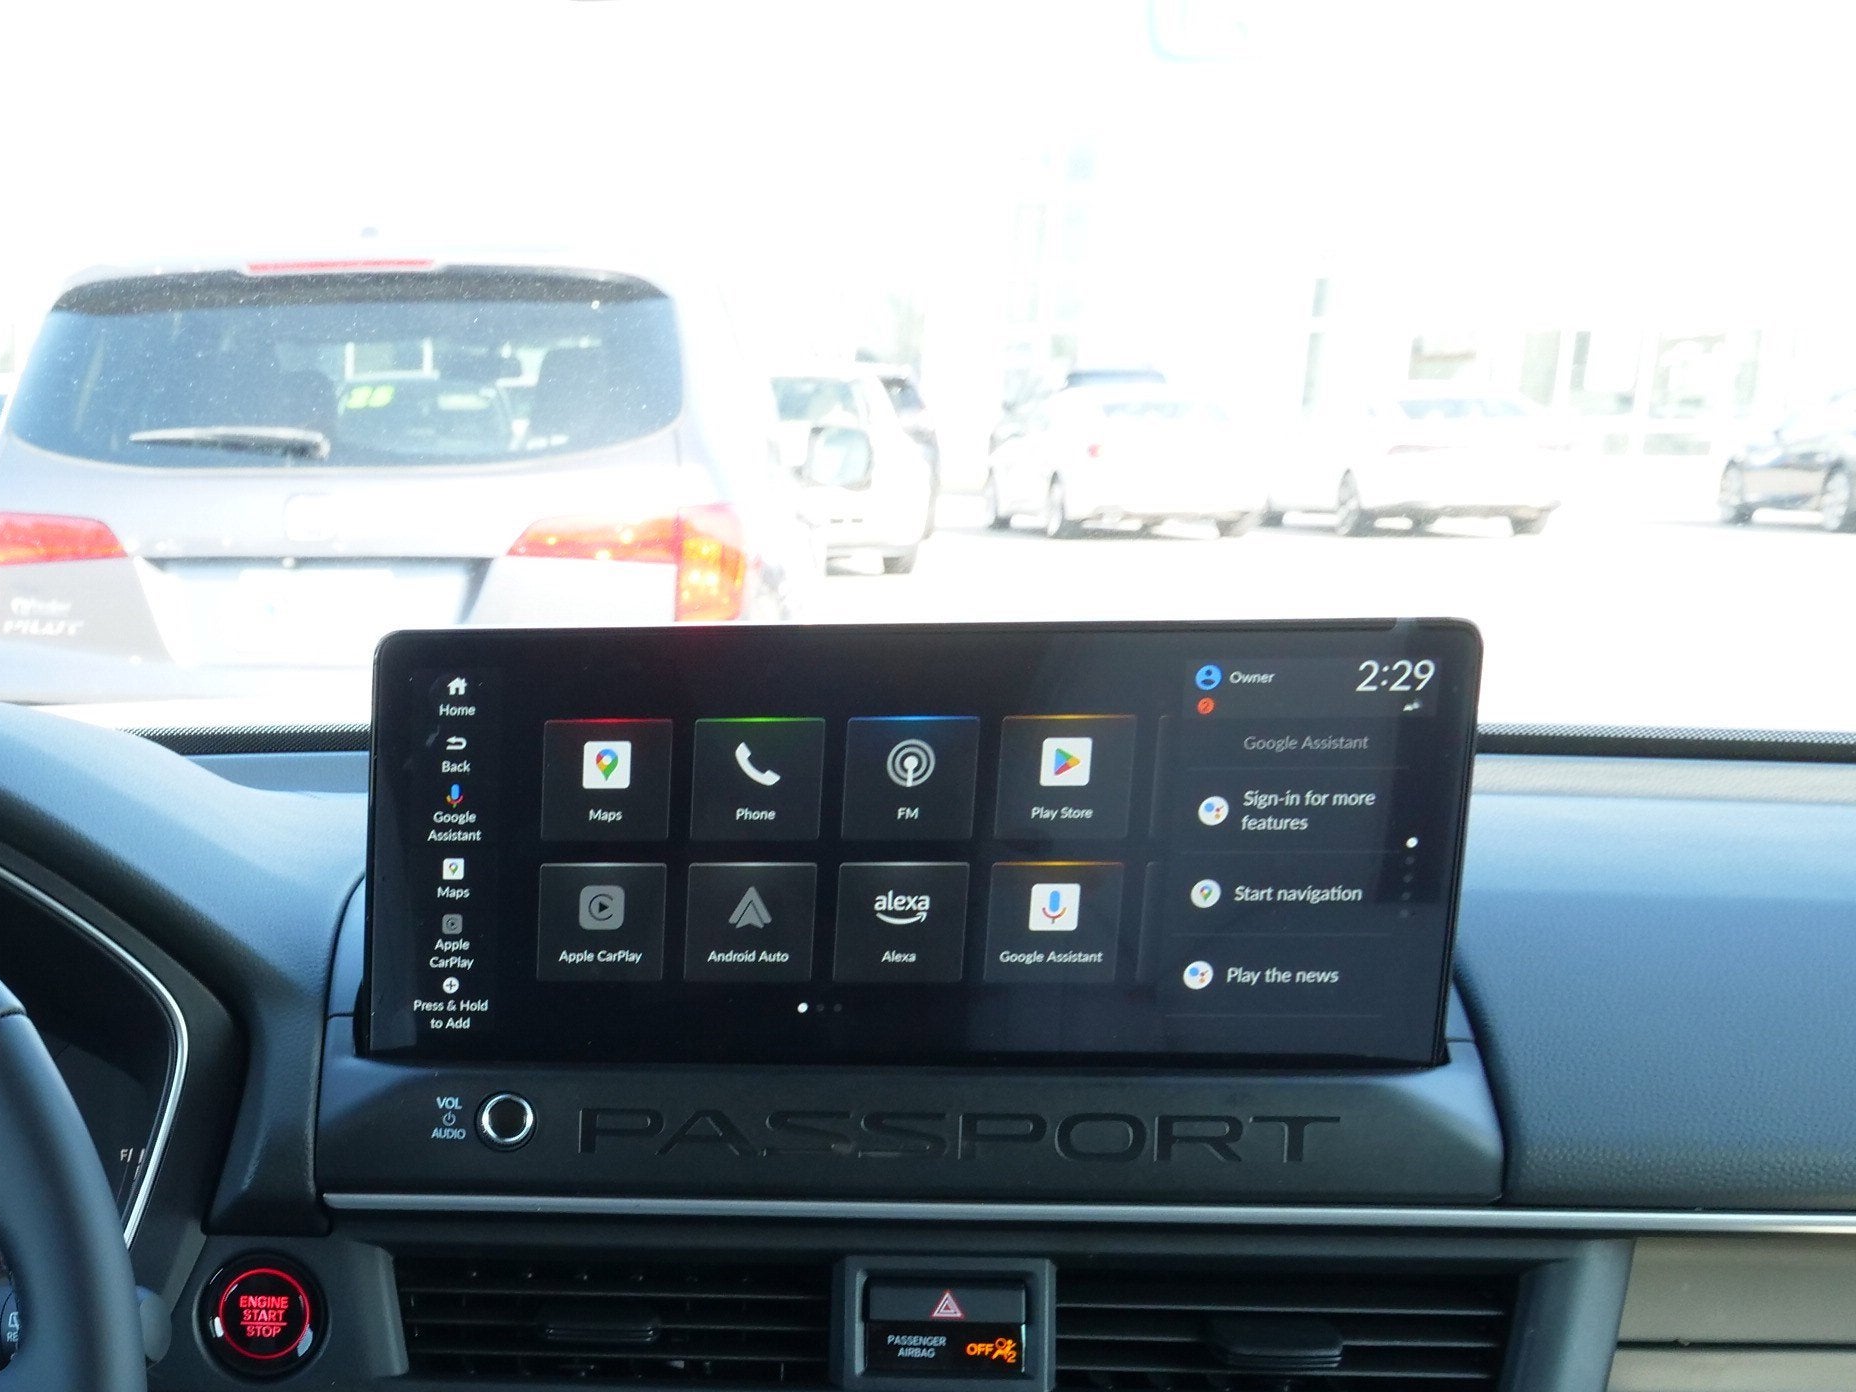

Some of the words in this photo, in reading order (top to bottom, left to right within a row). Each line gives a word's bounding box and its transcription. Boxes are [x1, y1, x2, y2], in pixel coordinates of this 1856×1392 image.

[1229, 671, 1275, 684] Owner
[1355, 659, 1436, 693] 2:29
[439, 704, 476, 716] Home
[1243, 735, 1298, 752] Google
[1301, 734, 1369, 751] Assistant
[442, 760, 471, 773] Back
[1243, 790, 1300, 809] Sign-in
[1304, 790, 1329, 806] for
[1332, 792, 1376, 806] more
[433, 811, 477, 825] Google
[589, 809, 623, 823] Maps
[736, 807, 776, 821] Phone
[897, 808, 919, 820] FM
[1031, 806, 1056, 821] Play
[1057, 805, 1093, 819] Store
[1241, 815, 1309, 831] features
[427, 828, 482, 842] Assistant
[437, 887, 470, 901] Maps
[874, 889, 931, 913] alexa
[1234, 885, 1273, 902] Start
[1276, 885, 1363, 903] navigation
[434, 939, 470, 953] Apple
[429, 955, 474, 970] CarPlay
[558, 949, 595, 964] Apple
[597, 949, 643, 965] CarPlay
[707, 949, 756, 963] Android
[758, 949, 789, 963] Auto
[881, 949, 917, 963] Alexa
[999, 950, 1044, 965] Google
[1046, 950, 1103, 964] Assistant
[1226, 967, 1262, 986] Play
[1264, 967, 1291, 984] the
[1294, 971, 1339, 984] news
[413, 999, 444, 1012] Press
[446, 999, 457, 1012] &
[458, 999, 489, 1012] Hold
[430, 1017, 441, 1030] to
[443, 1017, 471, 1030] Add
[435, 1096, 462, 1110] VOL
[431, 1127, 466, 1140] AUDIO
[578, 1106, 1342, 1165] PASSPORT
[239, 1295, 289, 1309] ENGINE
[243, 1309, 286, 1322] START
[6, 1332, 19, 1343] RE
[246, 1325, 282, 1338] STOP
[887, 1335, 947, 1347] PASSENGER
[897, 1347, 936, 1359] AIRBAG
[966, 1343, 994, 1356] OFF
